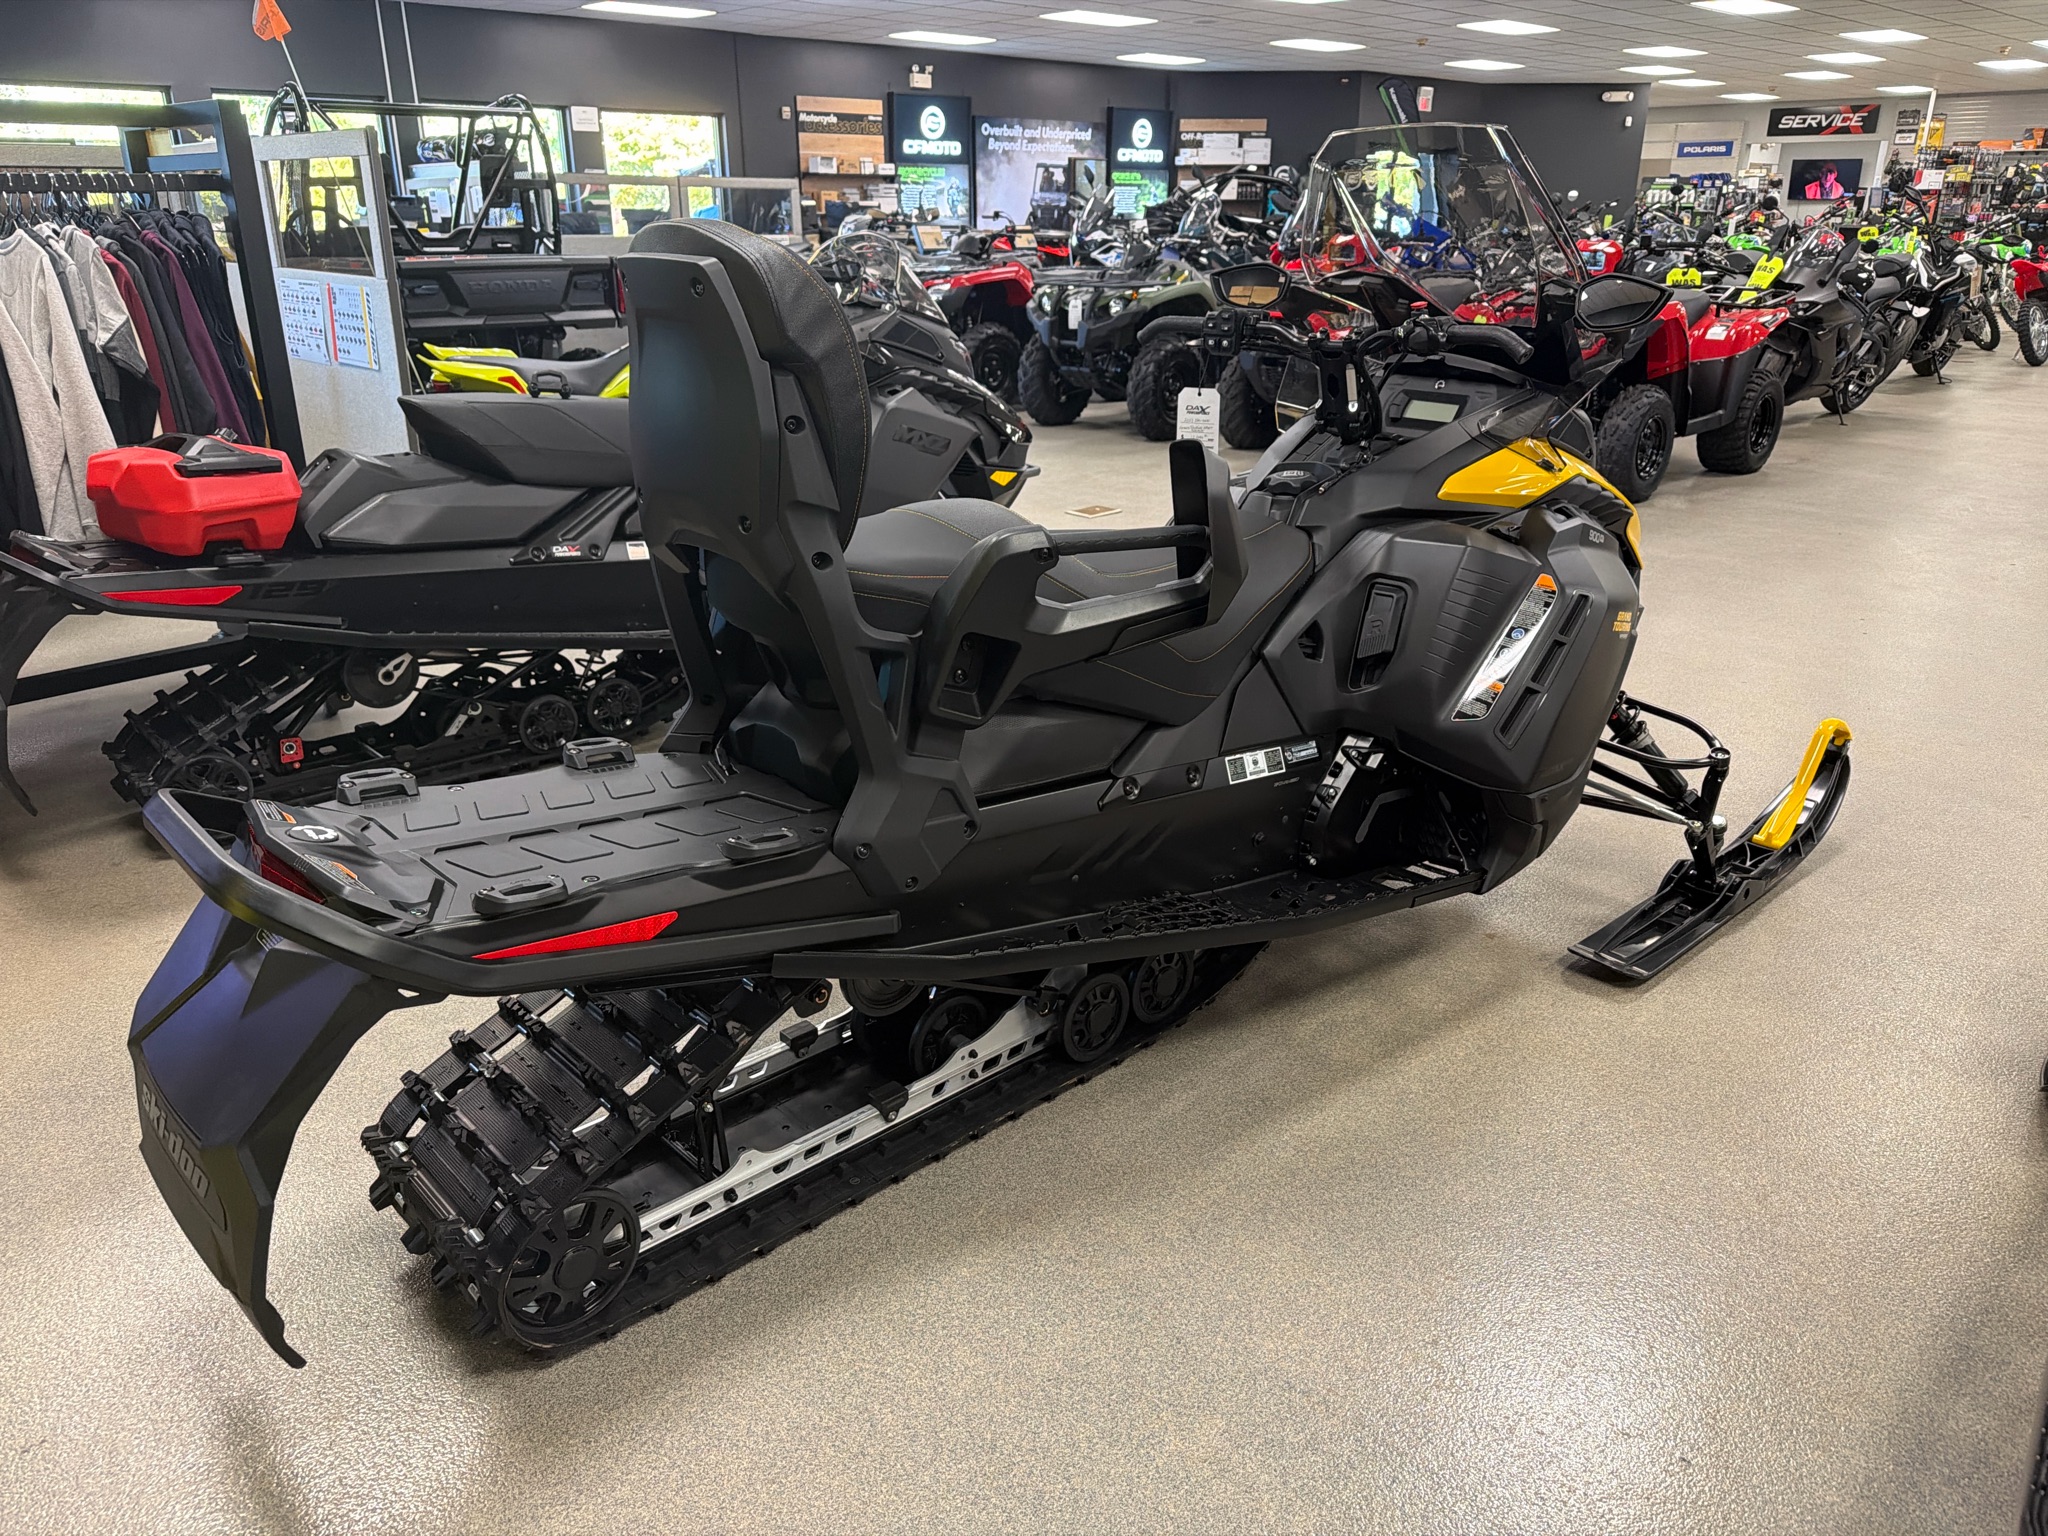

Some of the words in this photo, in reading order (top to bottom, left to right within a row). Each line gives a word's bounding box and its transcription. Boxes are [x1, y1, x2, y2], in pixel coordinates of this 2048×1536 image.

[799, 113, 838, 125] Motorcycle
[805, 119, 882, 134] accessories
[1778, 112, 1868, 129] SERVICE
[981, 122, 1023, 137] Overbuilt
[1024, 126, 1041, 139] and
[1042, 127, 1092, 142] Underpriced
[903, 139, 962, 156] CFMOTO
[988, 138, 1021, 153] Beyond
[1022, 140, 1077, 154] Expectations.
[1683, 144, 1727, 154] POLARIS
[1117, 148, 1164, 163] CFMOTO
[1757, 264, 1776, 274] WAS
[467, 279, 558, 295] HONDA
